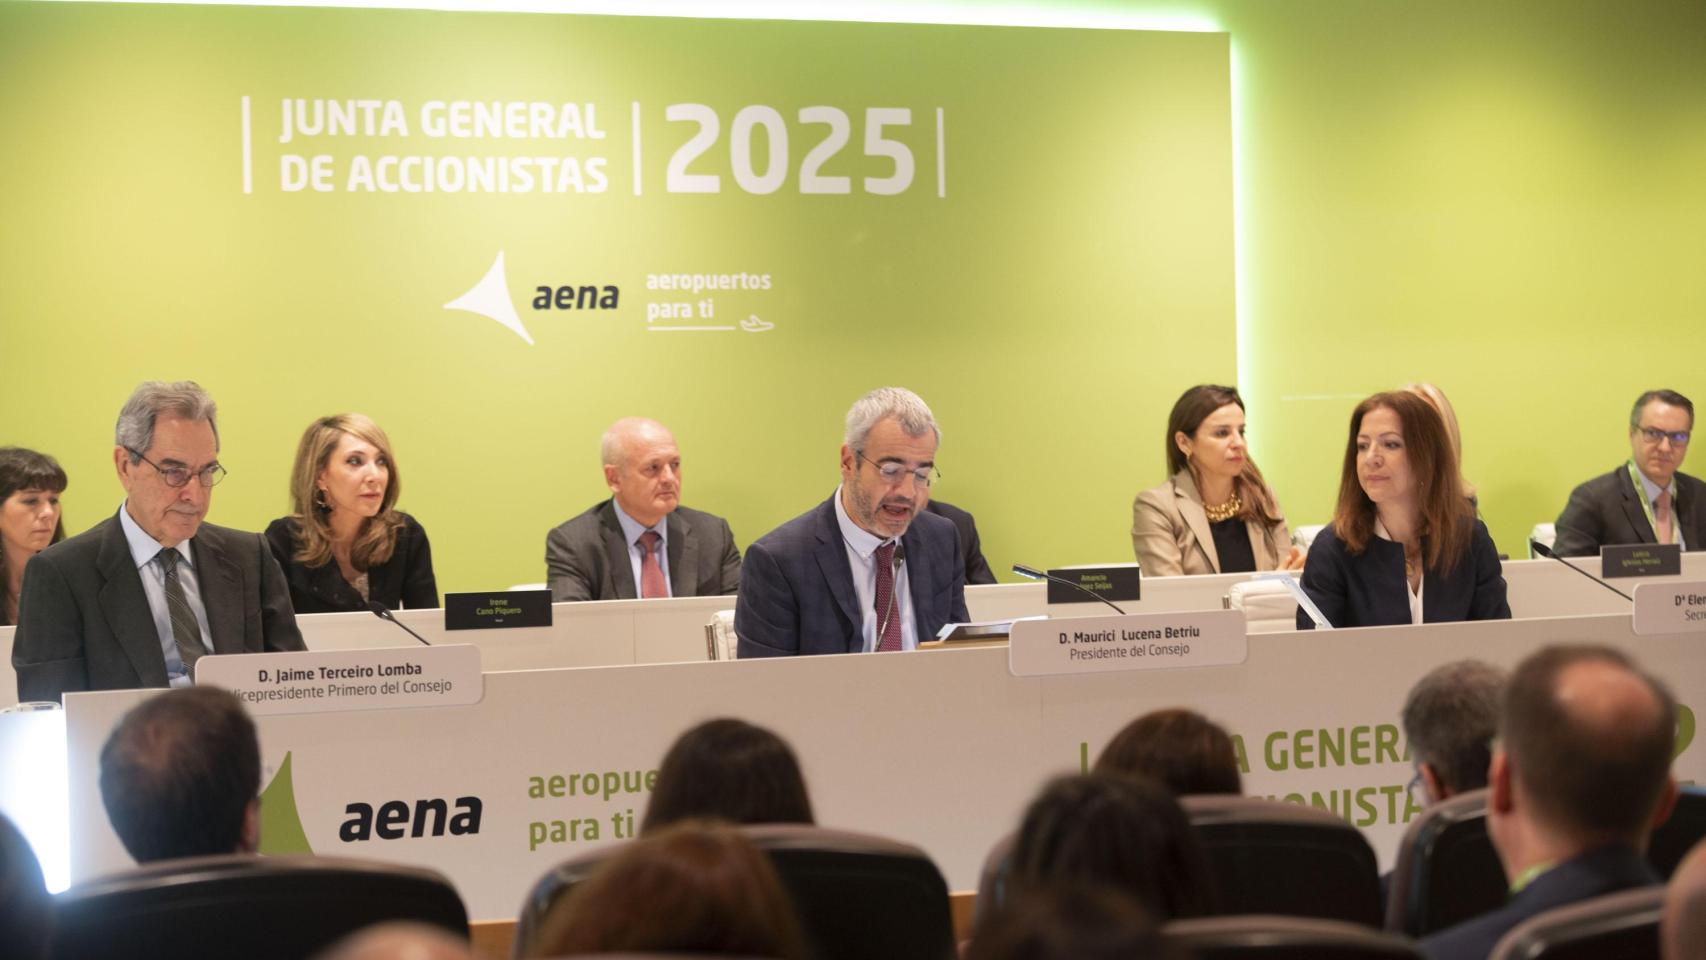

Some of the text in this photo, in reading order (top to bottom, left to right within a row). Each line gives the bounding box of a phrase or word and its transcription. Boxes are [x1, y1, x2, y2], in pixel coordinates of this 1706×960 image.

[279, 99, 606, 143] JUNTA GENERAL
[665, 103, 916, 196] 2025
[280, 154, 608, 194] DE ACCIONISTAS
[532, 283, 620, 312] aena
[645, 272, 772, 294] aeropuertos
[646, 298, 714, 323] para ti
[476, 607, 493, 615] Cano
[1059, 625, 1200, 645] D. Maurici Lucena Betriu
[1070, 643, 1190, 661] Presidente del Consejo
[258, 661, 422, 684] D. Jaime Terceiro Lomba
[232, 678, 453, 703] icepresidente Primero del Consejo
[1264, 723, 1411, 772] GENER
[528, 769, 659, 801] aeropue
[338, 795, 483, 842] aena
[529, 808, 634, 851] para ti
